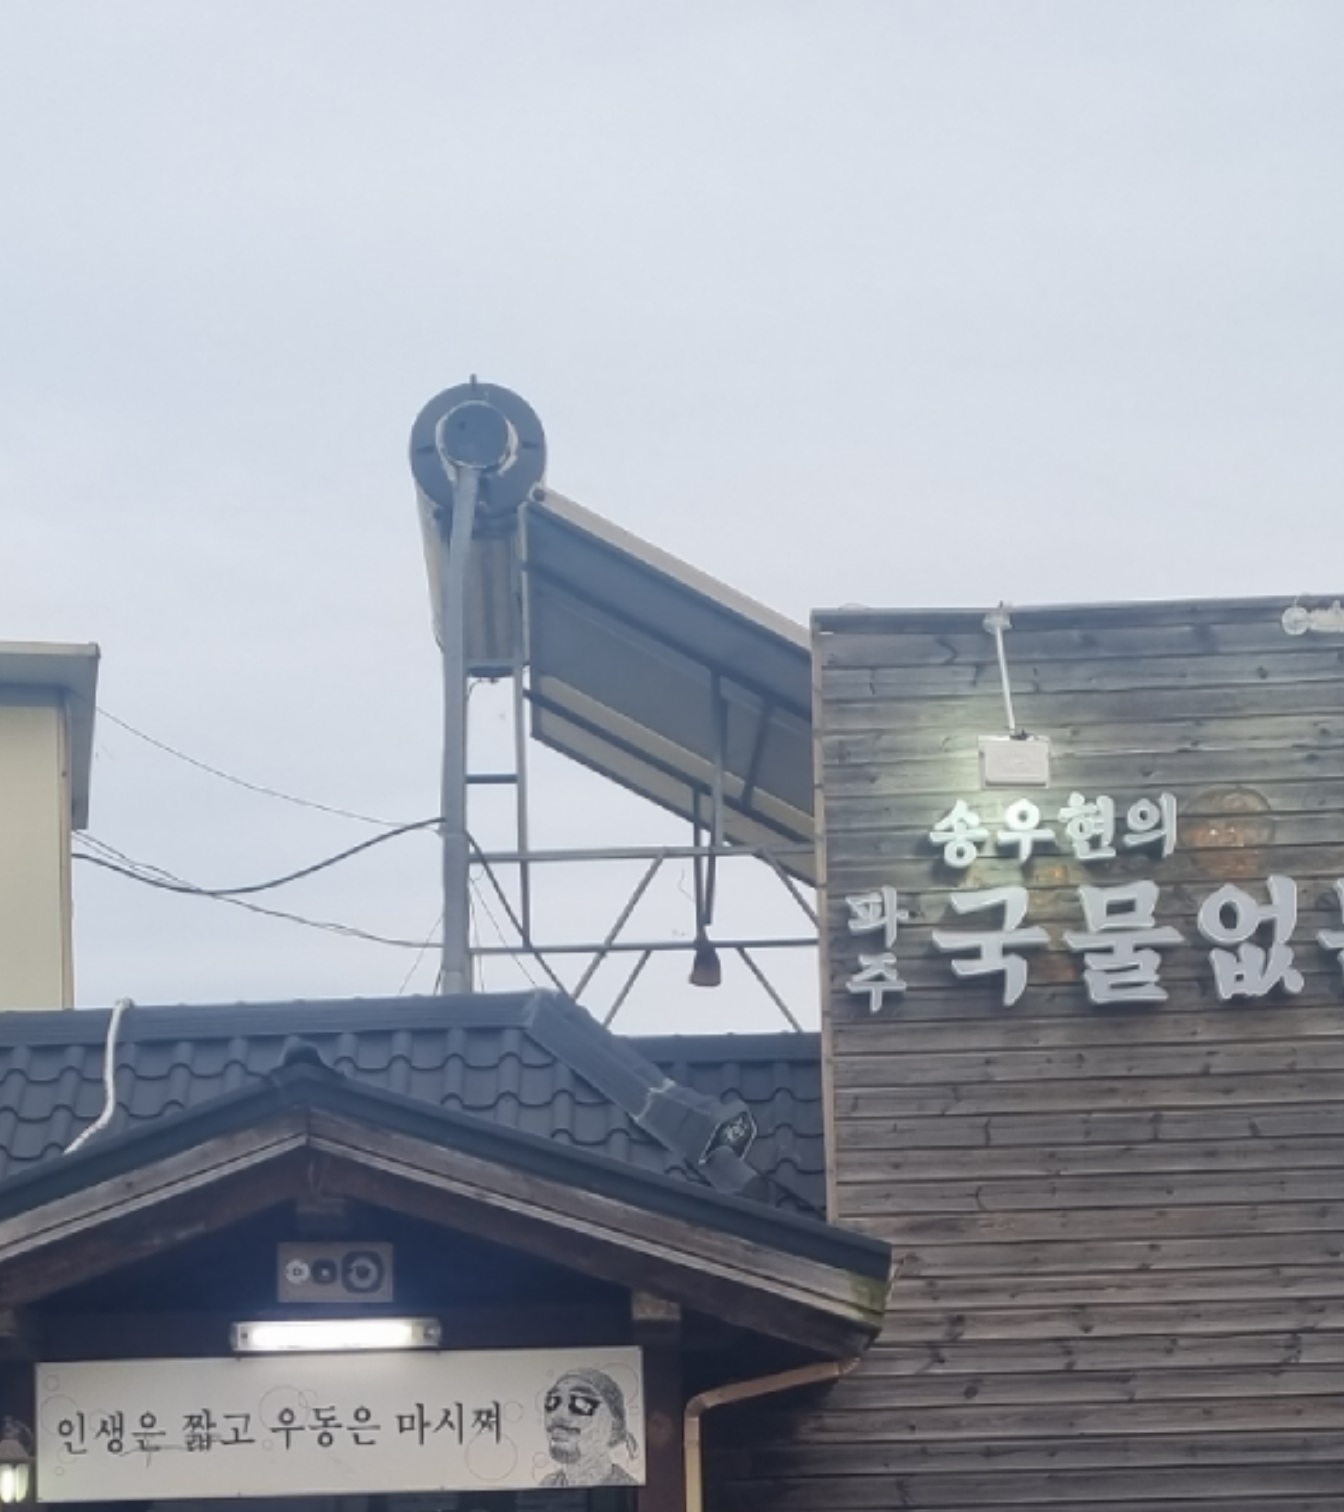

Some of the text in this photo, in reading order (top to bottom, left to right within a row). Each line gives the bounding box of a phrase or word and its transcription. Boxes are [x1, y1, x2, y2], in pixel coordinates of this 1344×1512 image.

[928, 791, 1178, 868] 송우현의
[844, 884, 910, 1013] 파주
[56, 1410, 167, 1454] 인생은
[183, 1409, 256, 1452] 짧고
[269, 1404, 382, 1450] 우동은
